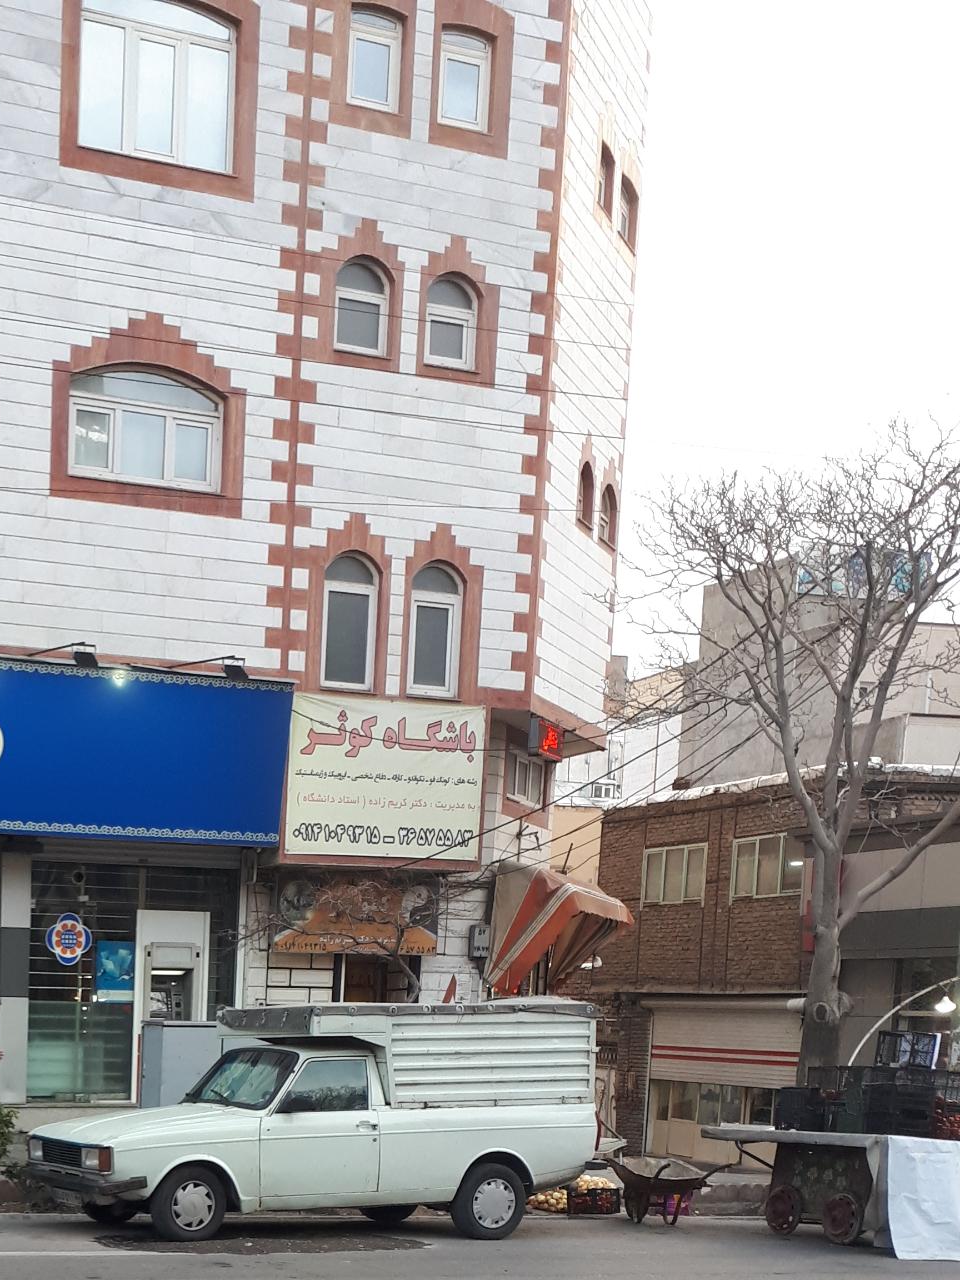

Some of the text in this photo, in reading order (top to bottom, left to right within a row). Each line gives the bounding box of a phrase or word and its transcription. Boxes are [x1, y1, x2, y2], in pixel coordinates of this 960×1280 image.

[300, 709, 477, 763] باشگاه کوثر
[351, 772, 374, 782] شخصی
[368, 797, 386, 809] زاده
[388, 797, 407, 810] کریم
[408, 799, 427, 810] دکتر
[434, 800, 465, 812] مدیریت
